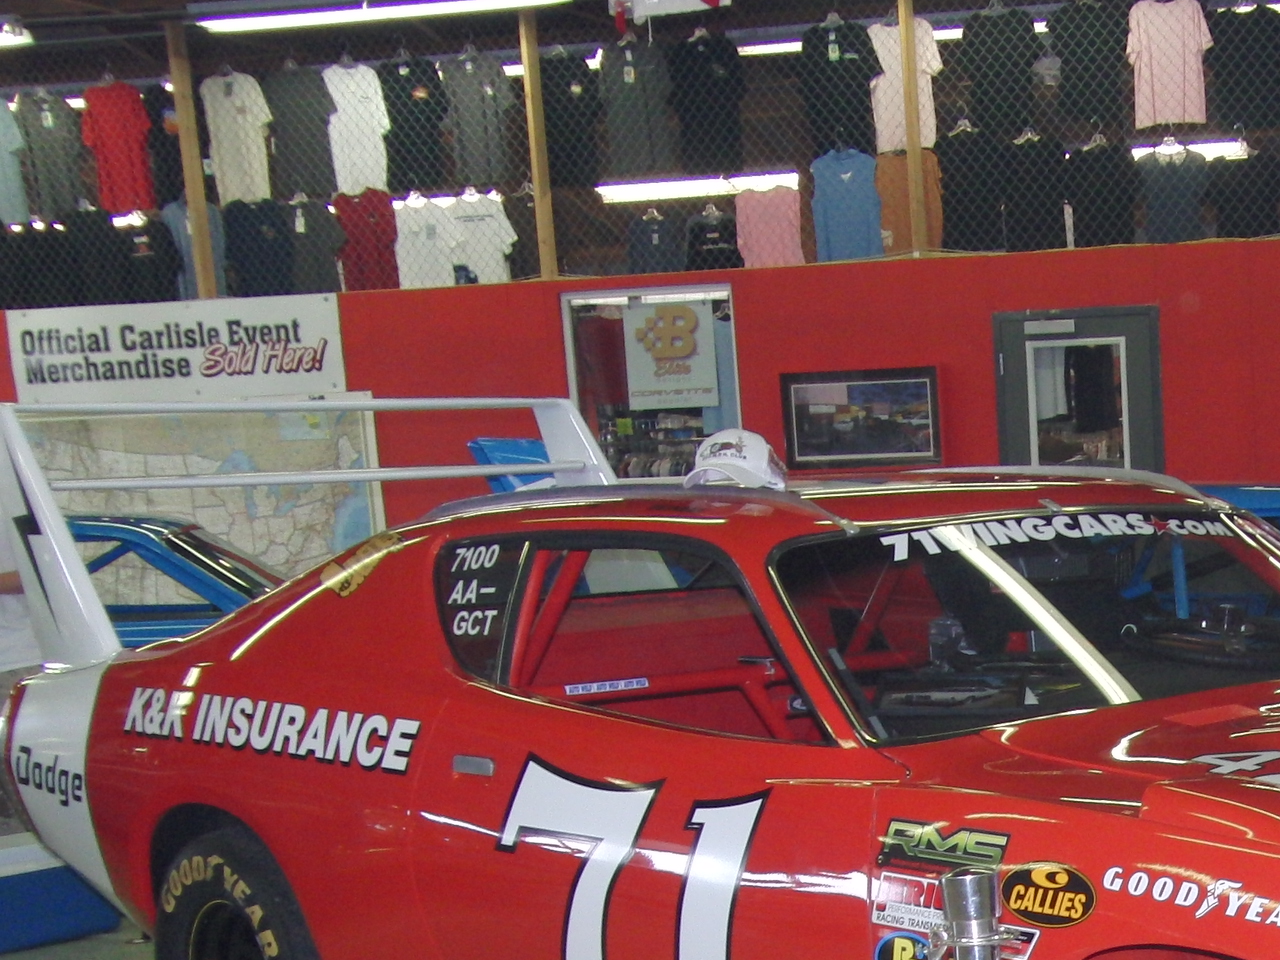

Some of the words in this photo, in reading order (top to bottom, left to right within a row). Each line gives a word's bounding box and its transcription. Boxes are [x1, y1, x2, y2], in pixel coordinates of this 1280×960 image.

[20, 327, 111, 356] Official
[119, 319, 220, 351] Carlisle
[226, 317, 301, 345] Event
[24, 352, 191, 384] Merchandise
[200, 342, 257, 377] Sold
[262, 337, 328, 374] Here!
[451, 544, 500, 572] 7100
[447, 578, 496, 605] AA-
[453, 610, 498, 636] GCT
[124, 687, 197, 740] K&K
[192, 693, 421, 773] INSURANCE
[15, 746, 84, 806] Dodge
[876, 912, 905, 926] RACING
[1009, 884, 1086, 919] CALLIES
